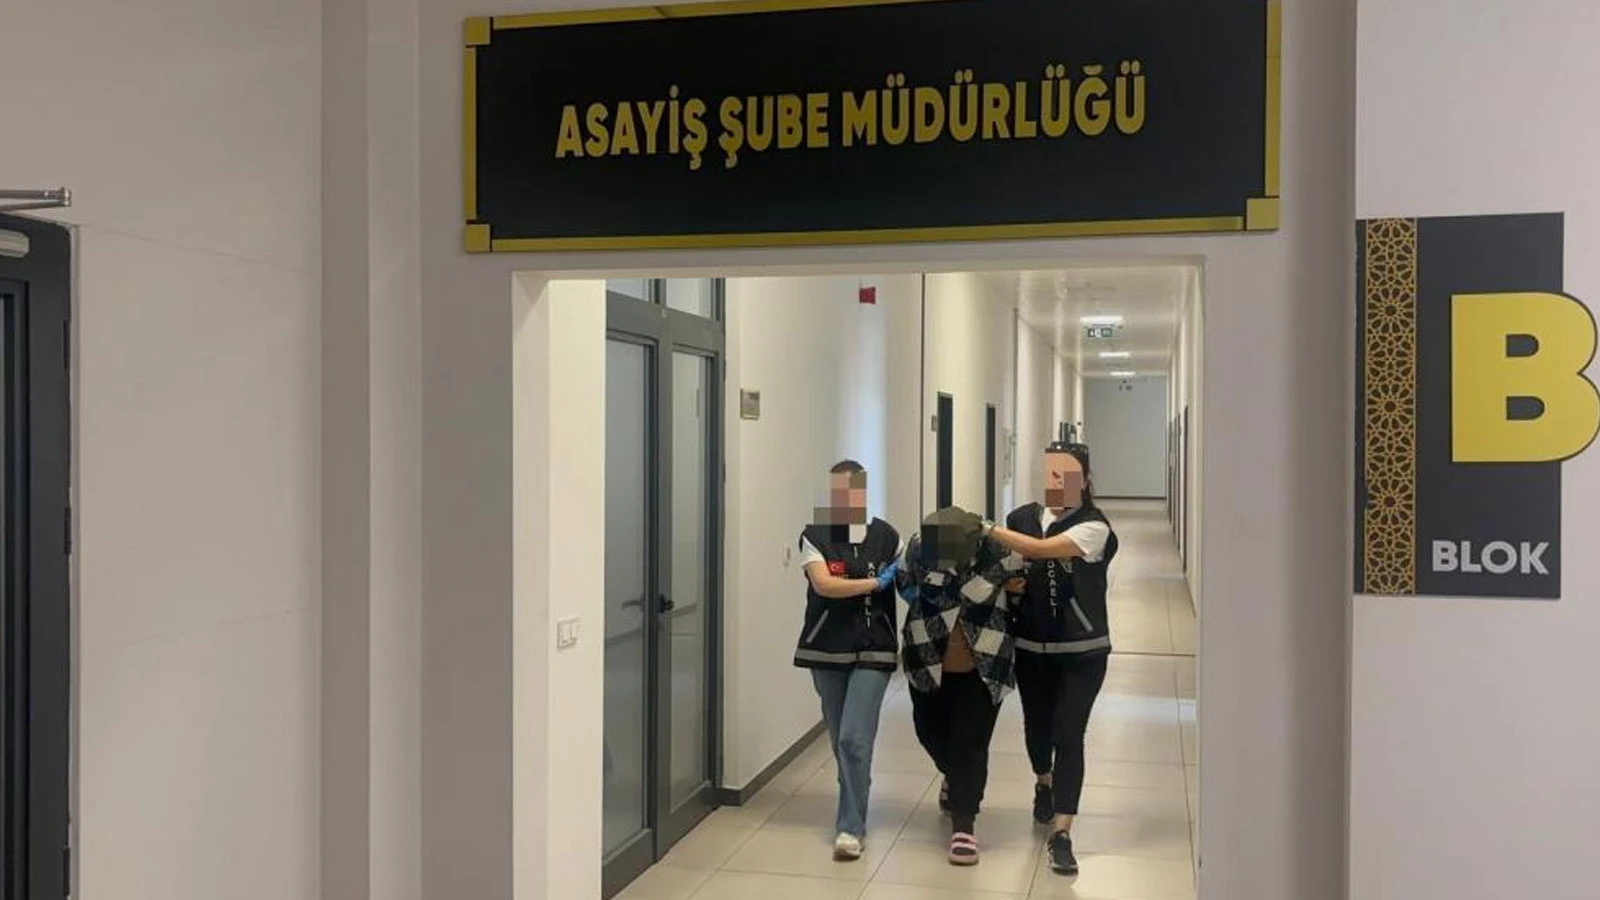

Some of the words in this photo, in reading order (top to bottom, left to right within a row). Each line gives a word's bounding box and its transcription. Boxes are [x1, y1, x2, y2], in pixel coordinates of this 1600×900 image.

[555, 84, 707, 170] ASAYİŞ
[719, 93, 830, 169] ŞUBE
[841, 60, 1146, 147] MÜDÜRLÜĞÜ
[1450, 292, 1600, 464] B
[1432, 539, 1550, 576] BLOK
